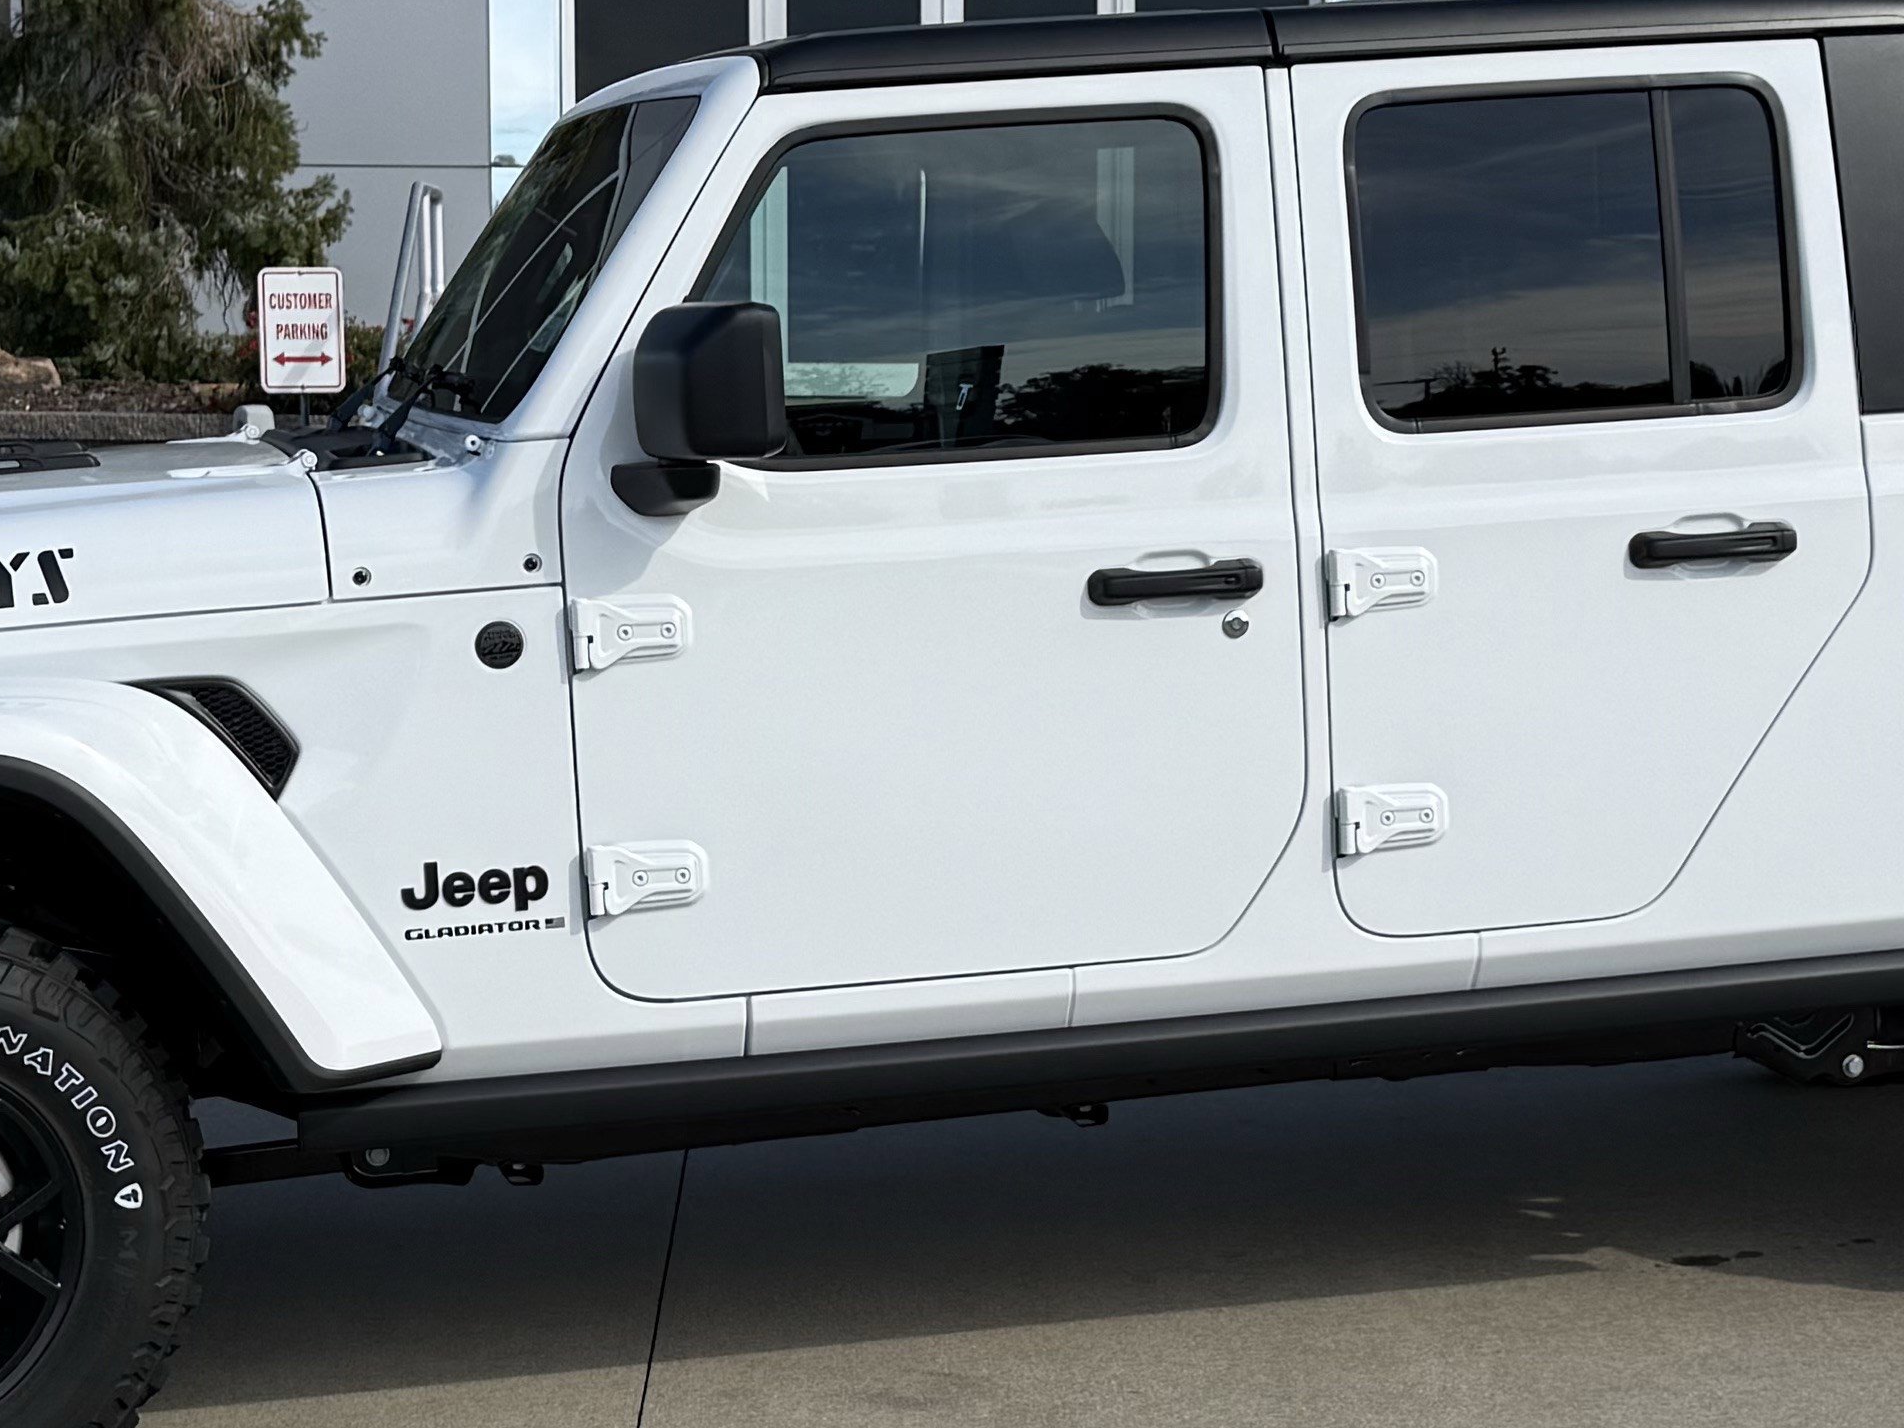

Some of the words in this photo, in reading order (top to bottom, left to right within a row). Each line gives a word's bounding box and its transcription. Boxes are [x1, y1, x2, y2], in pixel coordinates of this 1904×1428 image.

[269, 292, 333, 310] CUSTOMER
[275, 323, 329, 340] PARKING
[401, 861, 549, 912] Jeep
[404, 919, 541, 941] GLADIATOR
